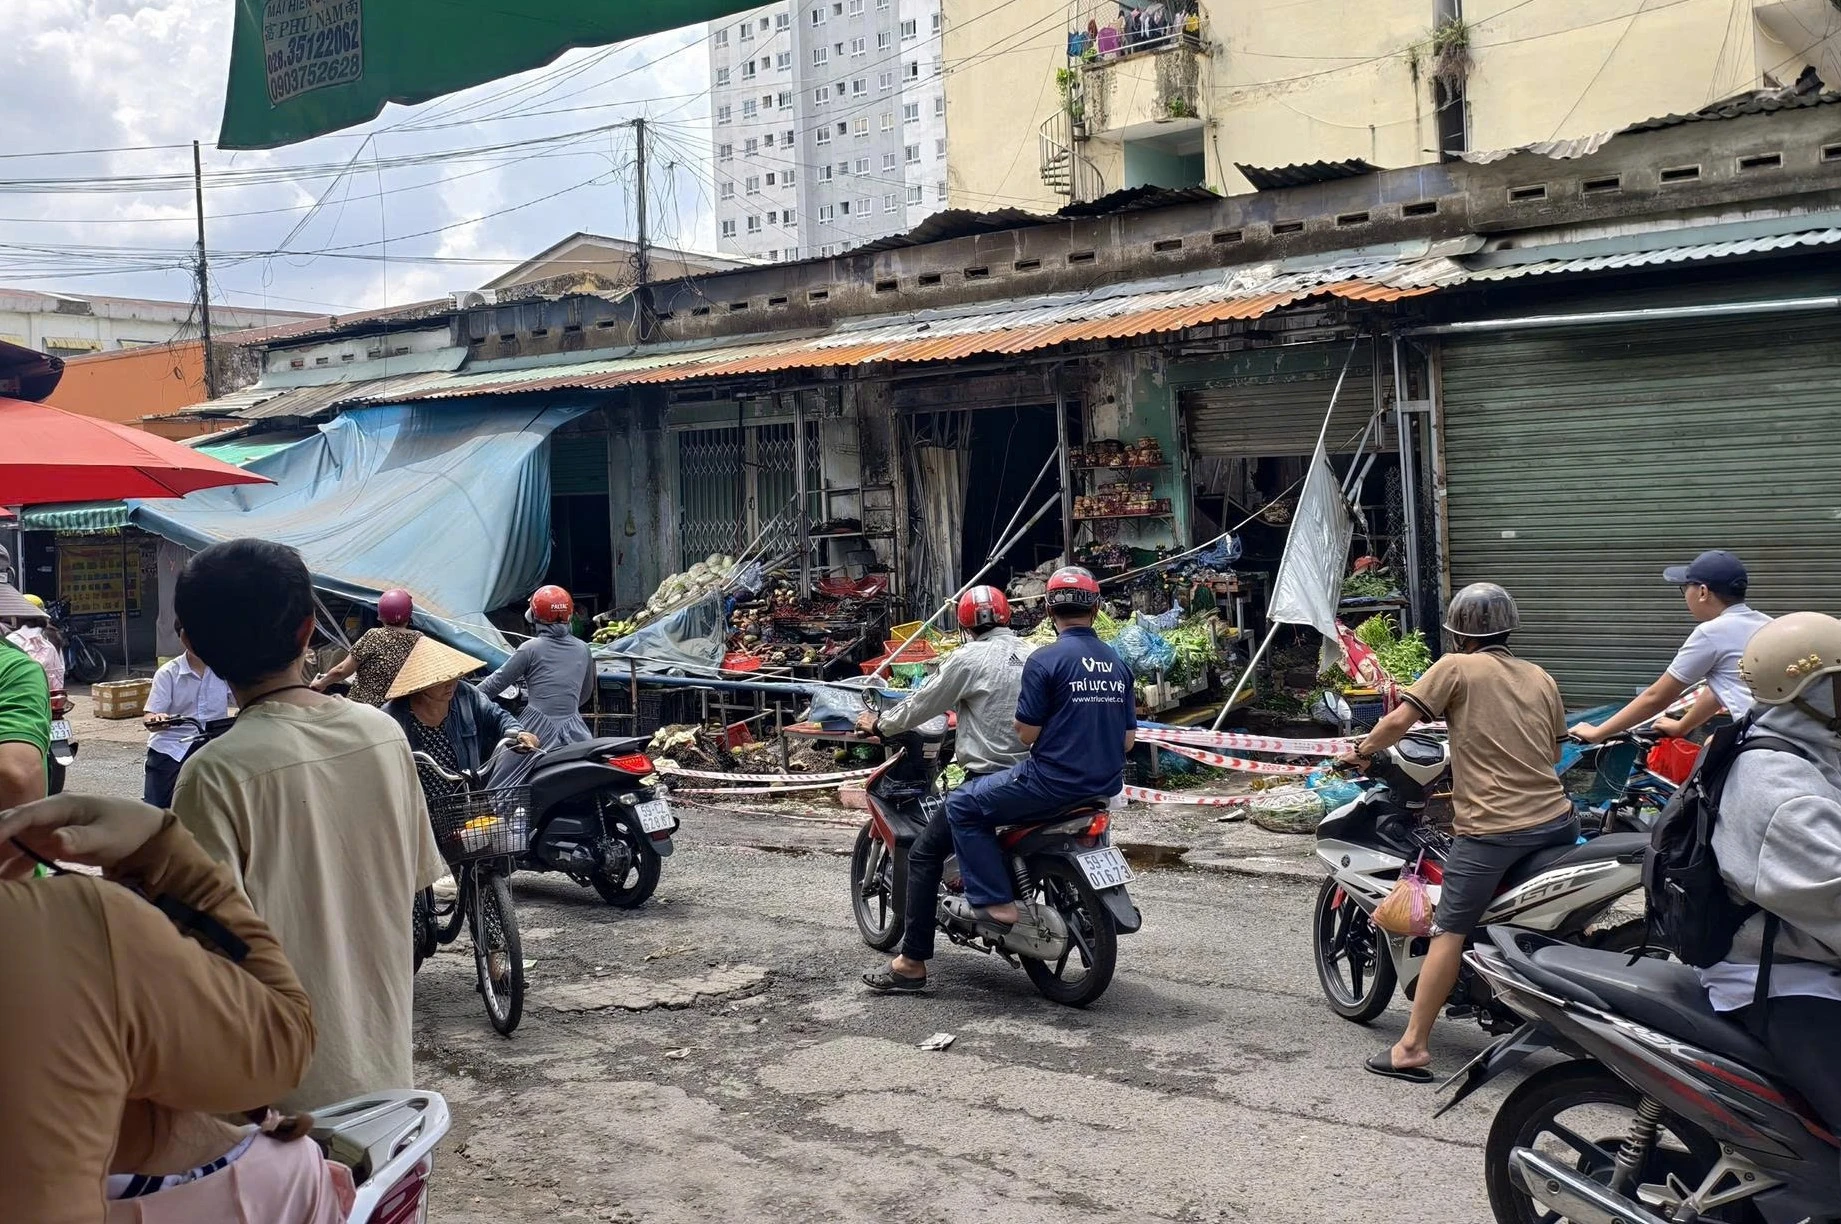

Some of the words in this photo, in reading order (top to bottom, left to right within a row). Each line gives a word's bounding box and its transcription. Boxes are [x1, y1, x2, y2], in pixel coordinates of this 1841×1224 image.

[279, 10, 312, 38] PHÚ
[316, 4, 344, 29] NAM
[270, 53, 360, 100] 0903752628
[1069, 677, 1087, 692] TRÍ
[1084, 851, 1118, 870] 59-Y1
[1089, 865, 1131, 887] 016.73
